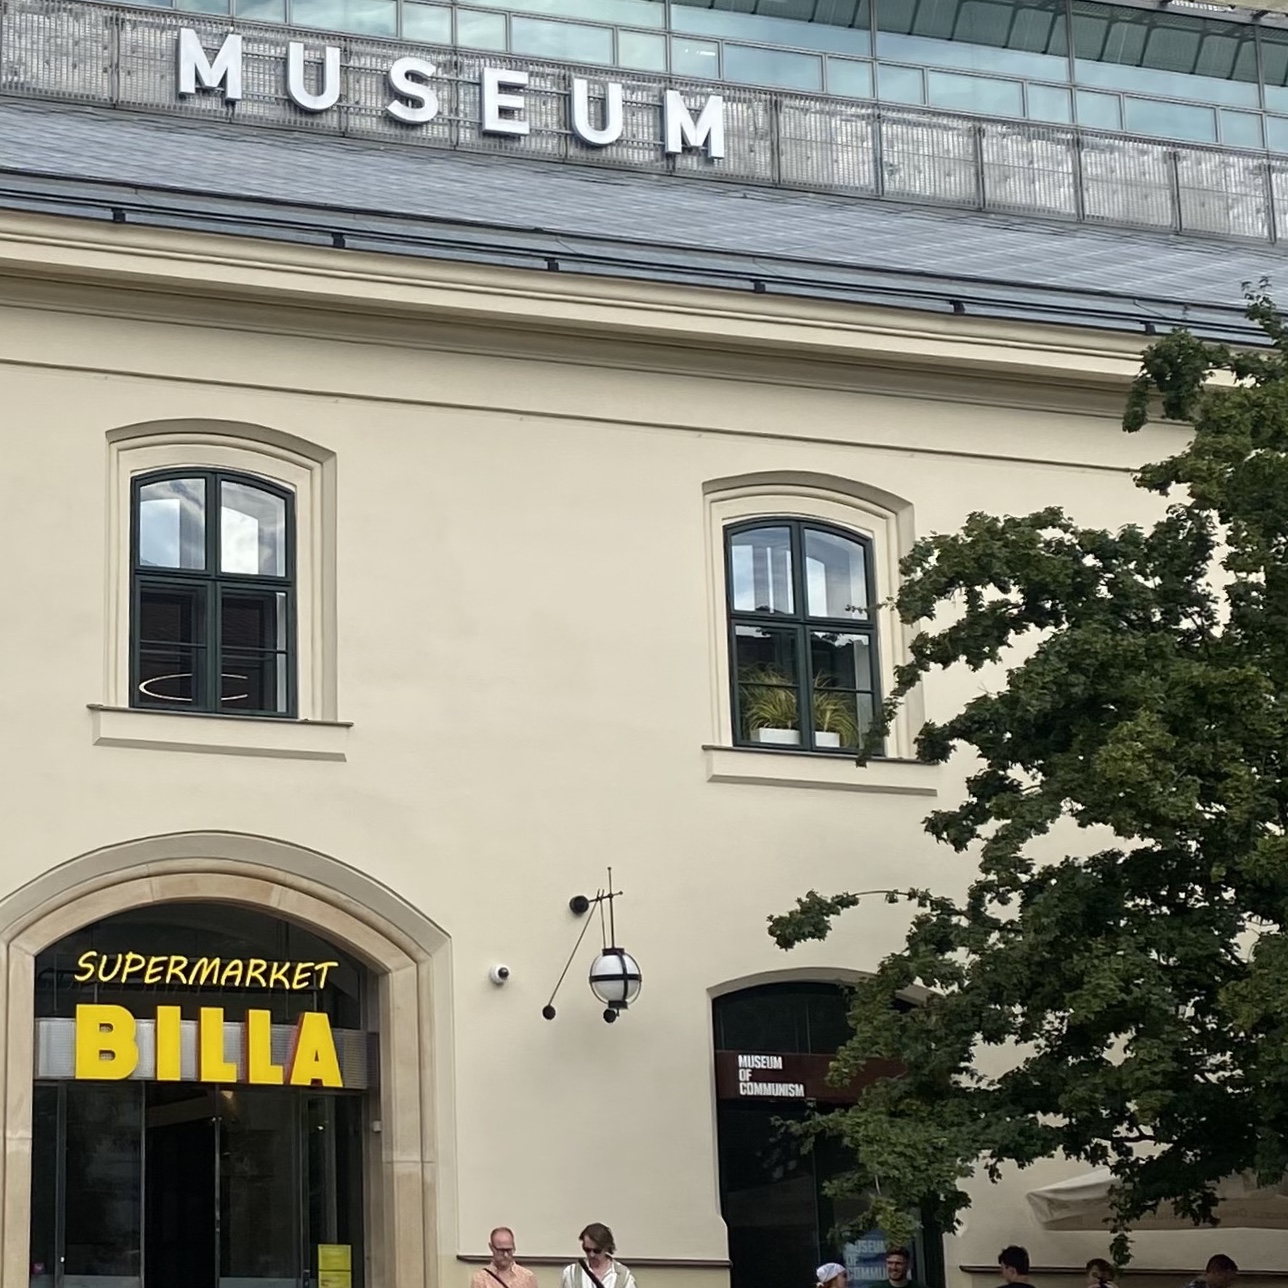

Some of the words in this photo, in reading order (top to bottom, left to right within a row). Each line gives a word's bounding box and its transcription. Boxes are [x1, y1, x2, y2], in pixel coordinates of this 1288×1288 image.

[178, 27, 725, 159] MUSEUM
[74, 951, 339, 990] SUPERMARKET
[75, 1004, 343, 1087] BILLA
[738, 1055, 783, 1069] MUSEUM
[739, 1068, 752, 1081] OF
[739, 1082, 804, 1096] COMMUNISM
